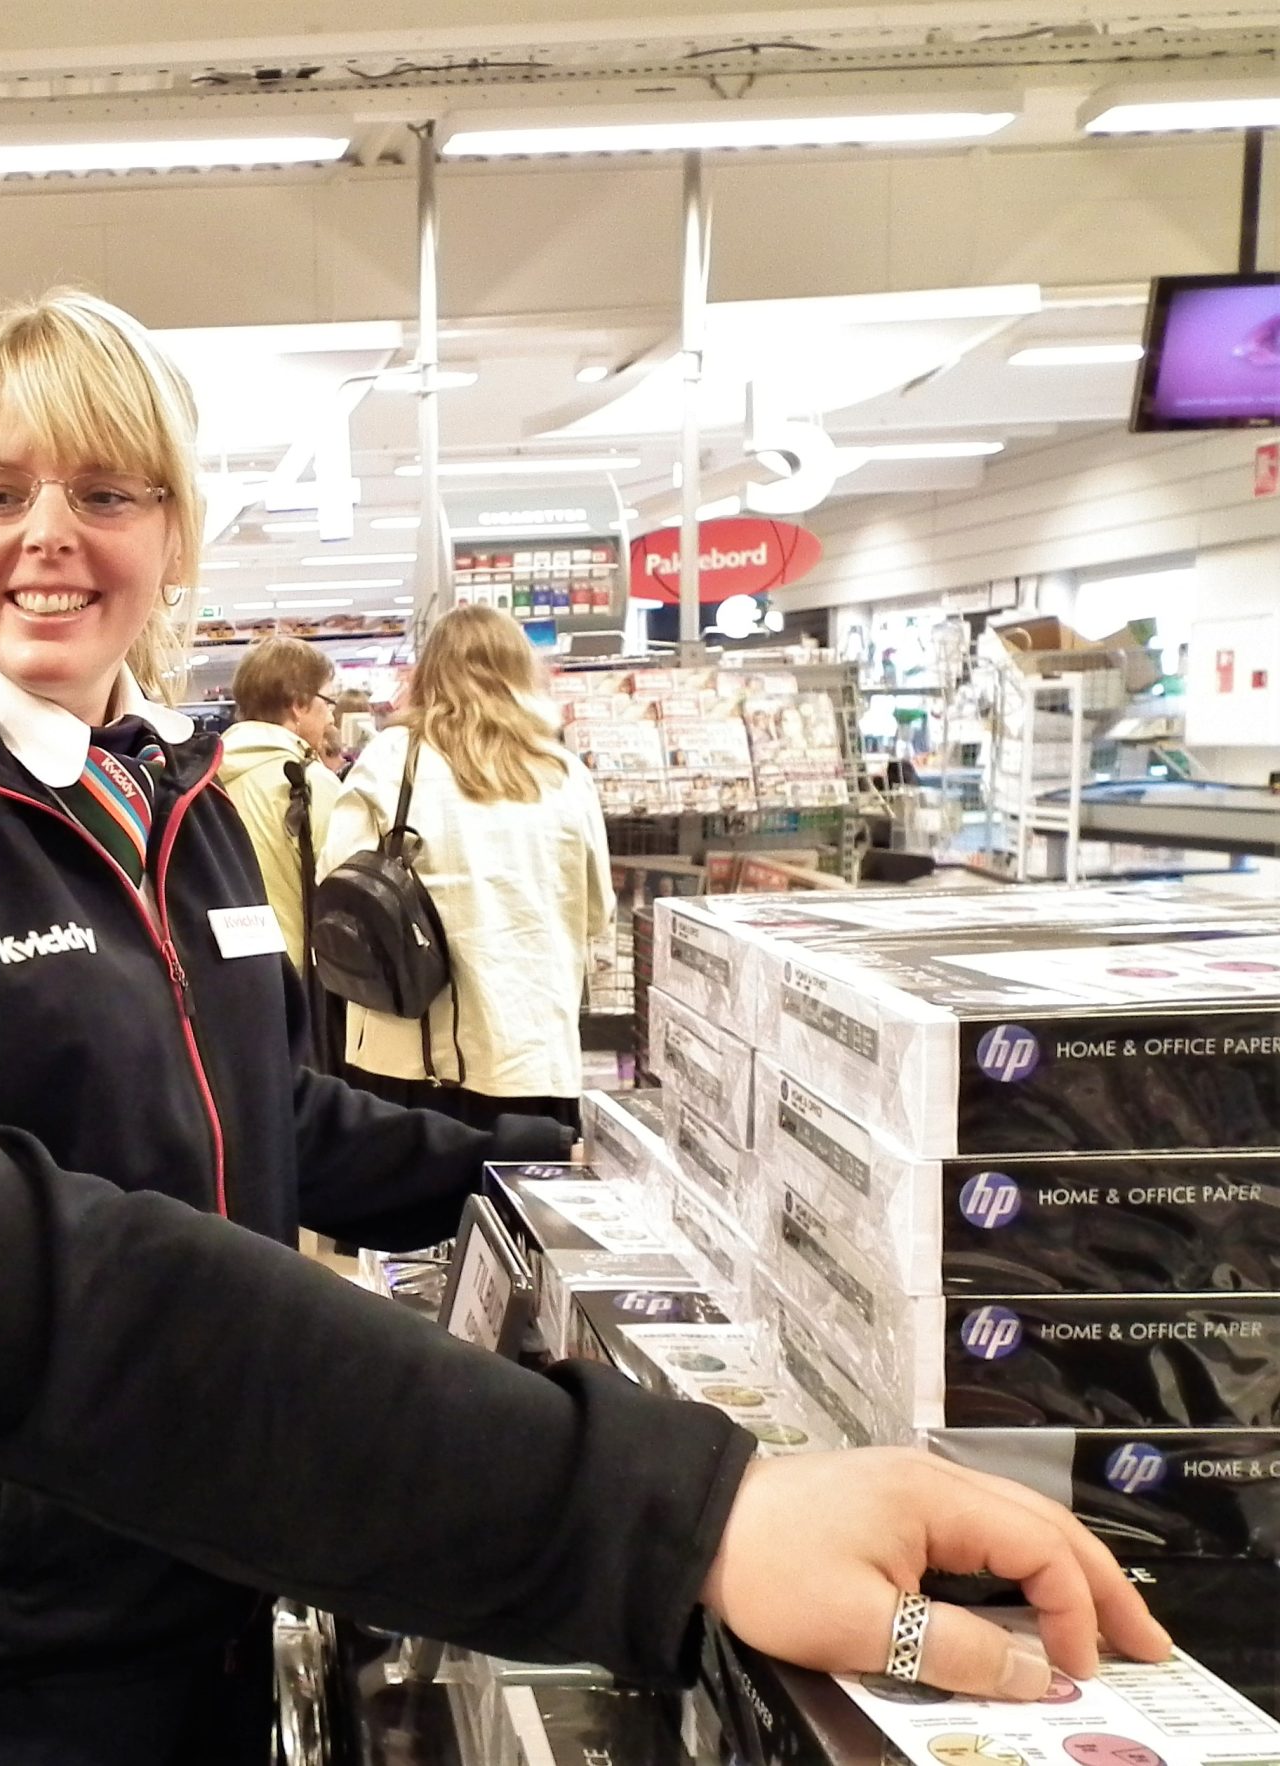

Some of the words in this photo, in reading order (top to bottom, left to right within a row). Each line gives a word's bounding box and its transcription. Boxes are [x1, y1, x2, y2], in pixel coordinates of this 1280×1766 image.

[265, 394, 361, 542] 4
[745, 381, 838, 514] 5
[646, 542, 768, 576] Pakebord
[101, 757, 137, 798] Kvickly
[982, 1025, 1036, 1082] hp
[1057, 1040, 1117, 1058] HOME
[1123, 1039, 1138, 1057] &
[1144, 1038, 1216, 1057] OFFICE
[1223, 1036, 1280, 1055] PAPER
[965, 1173, 1019, 1229] hp
[1038, 1188, 1099, 1206] HOME
[1106, 1188, 1121, 1205] &
[1128, 1186, 1197, 1204] OFFICE
[1203, 1184, 1262, 1203] PAPER
[621, 1291, 673, 1316] hp
[966, 1305, 1020, 1360] hp
[1041, 1323, 1102, 1341] HOME
[1109, 1323, 1123, 1340] &
[1129, 1321, 1197, 1340] OFFICE
[1203, 1320, 1263, 1338] PAPER
[1107, 1442, 1163, 1494] hp
[1183, 1459, 1243, 1478] HOME
[1249, 1460, 1262, 1477] &
